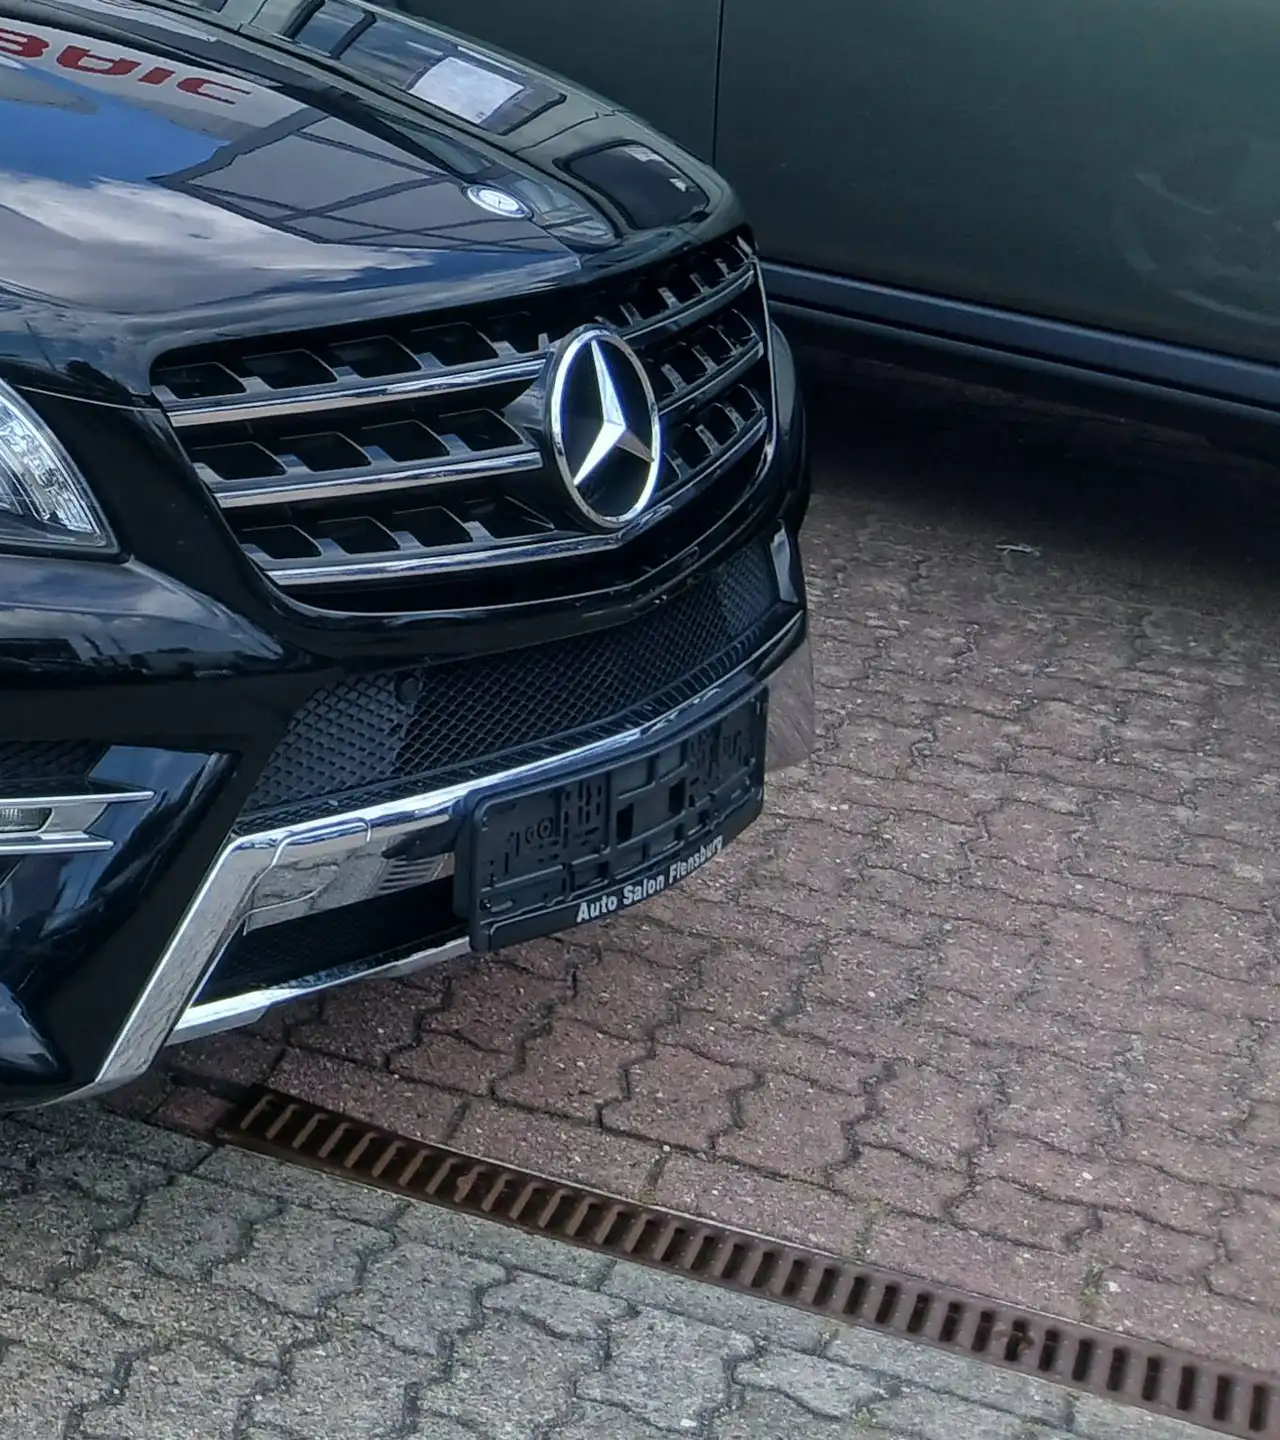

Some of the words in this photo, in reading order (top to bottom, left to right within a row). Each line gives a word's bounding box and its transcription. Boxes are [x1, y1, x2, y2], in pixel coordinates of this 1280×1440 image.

[576, 895, 618, 923] Auto
[622, 874, 665, 906] Salon
[668, 835, 723, 884] Flensburg
